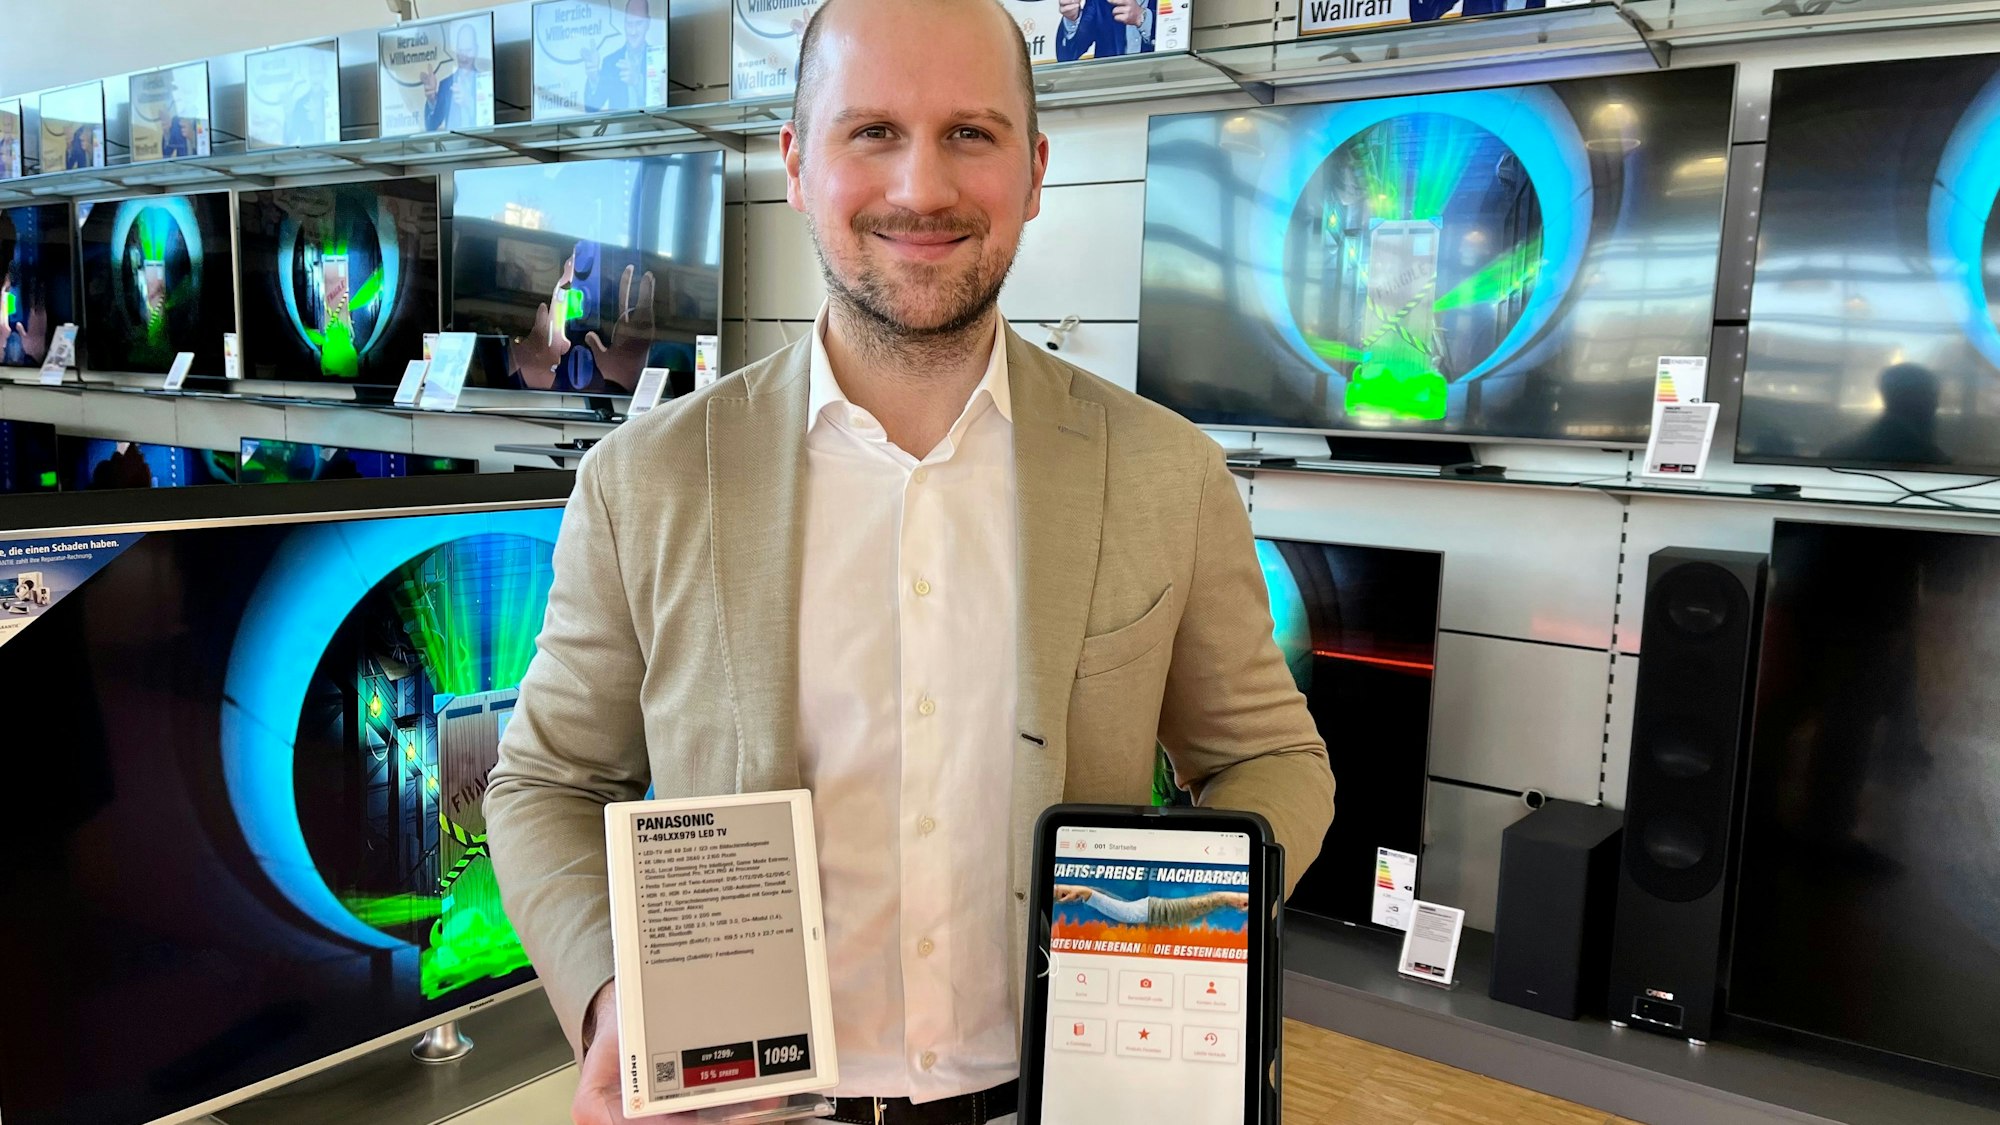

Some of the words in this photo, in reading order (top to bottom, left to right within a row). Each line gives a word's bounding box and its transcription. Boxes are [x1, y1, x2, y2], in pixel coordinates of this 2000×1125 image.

[737, 68, 787, 90] Wallraff
[9, 546, 23, 556] die
[25, 545, 50, 554] einen
[52, 541, 88, 552] Schaden
[90, 539, 119, 551] haben.
[637, 813, 714, 831] PANASONIC
[637, 831, 696, 843] TX-49LXX979
[699, 829, 714, 838] LED
[717, 827, 727, 836] TV
[1109, 843, 1136, 851] Startseite
[1072, 939, 1092, 951] VON
[1094, 941, 1141, 954] NEBENAN
[1154, 943, 1171, 955] DIE
[1173, 945, 1213, 957] BESTEN
[631, 1054, 639, 1094] expert
[701, 1070, 709, 1080] 15
[710, 1069, 717, 1078] %
